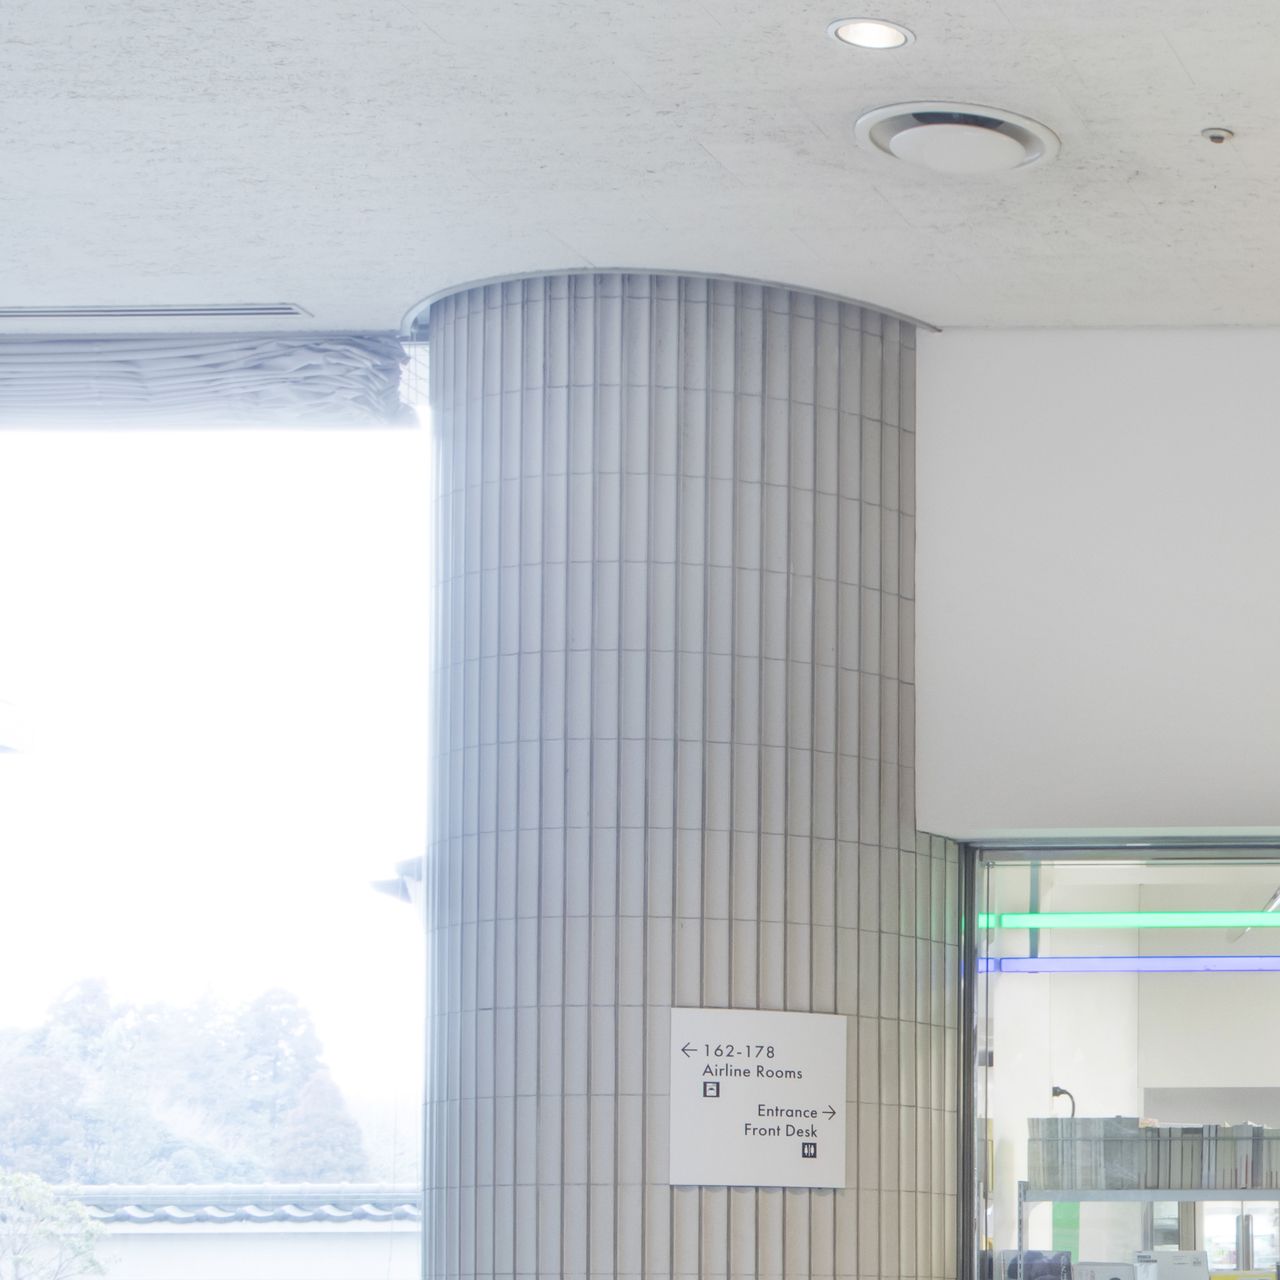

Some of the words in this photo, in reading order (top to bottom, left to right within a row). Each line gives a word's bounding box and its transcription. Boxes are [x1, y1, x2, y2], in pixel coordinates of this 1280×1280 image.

[704, 1044, 775, 1059] 162-178
[702, 1064, 751, 1078] Airline
[756, 1065, 803, 1079] Rooms
[757, 1104, 818, 1119] Entrance
[744, 1123, 781, 1137] Front
[785, 1124, 818, 1138] Desk
